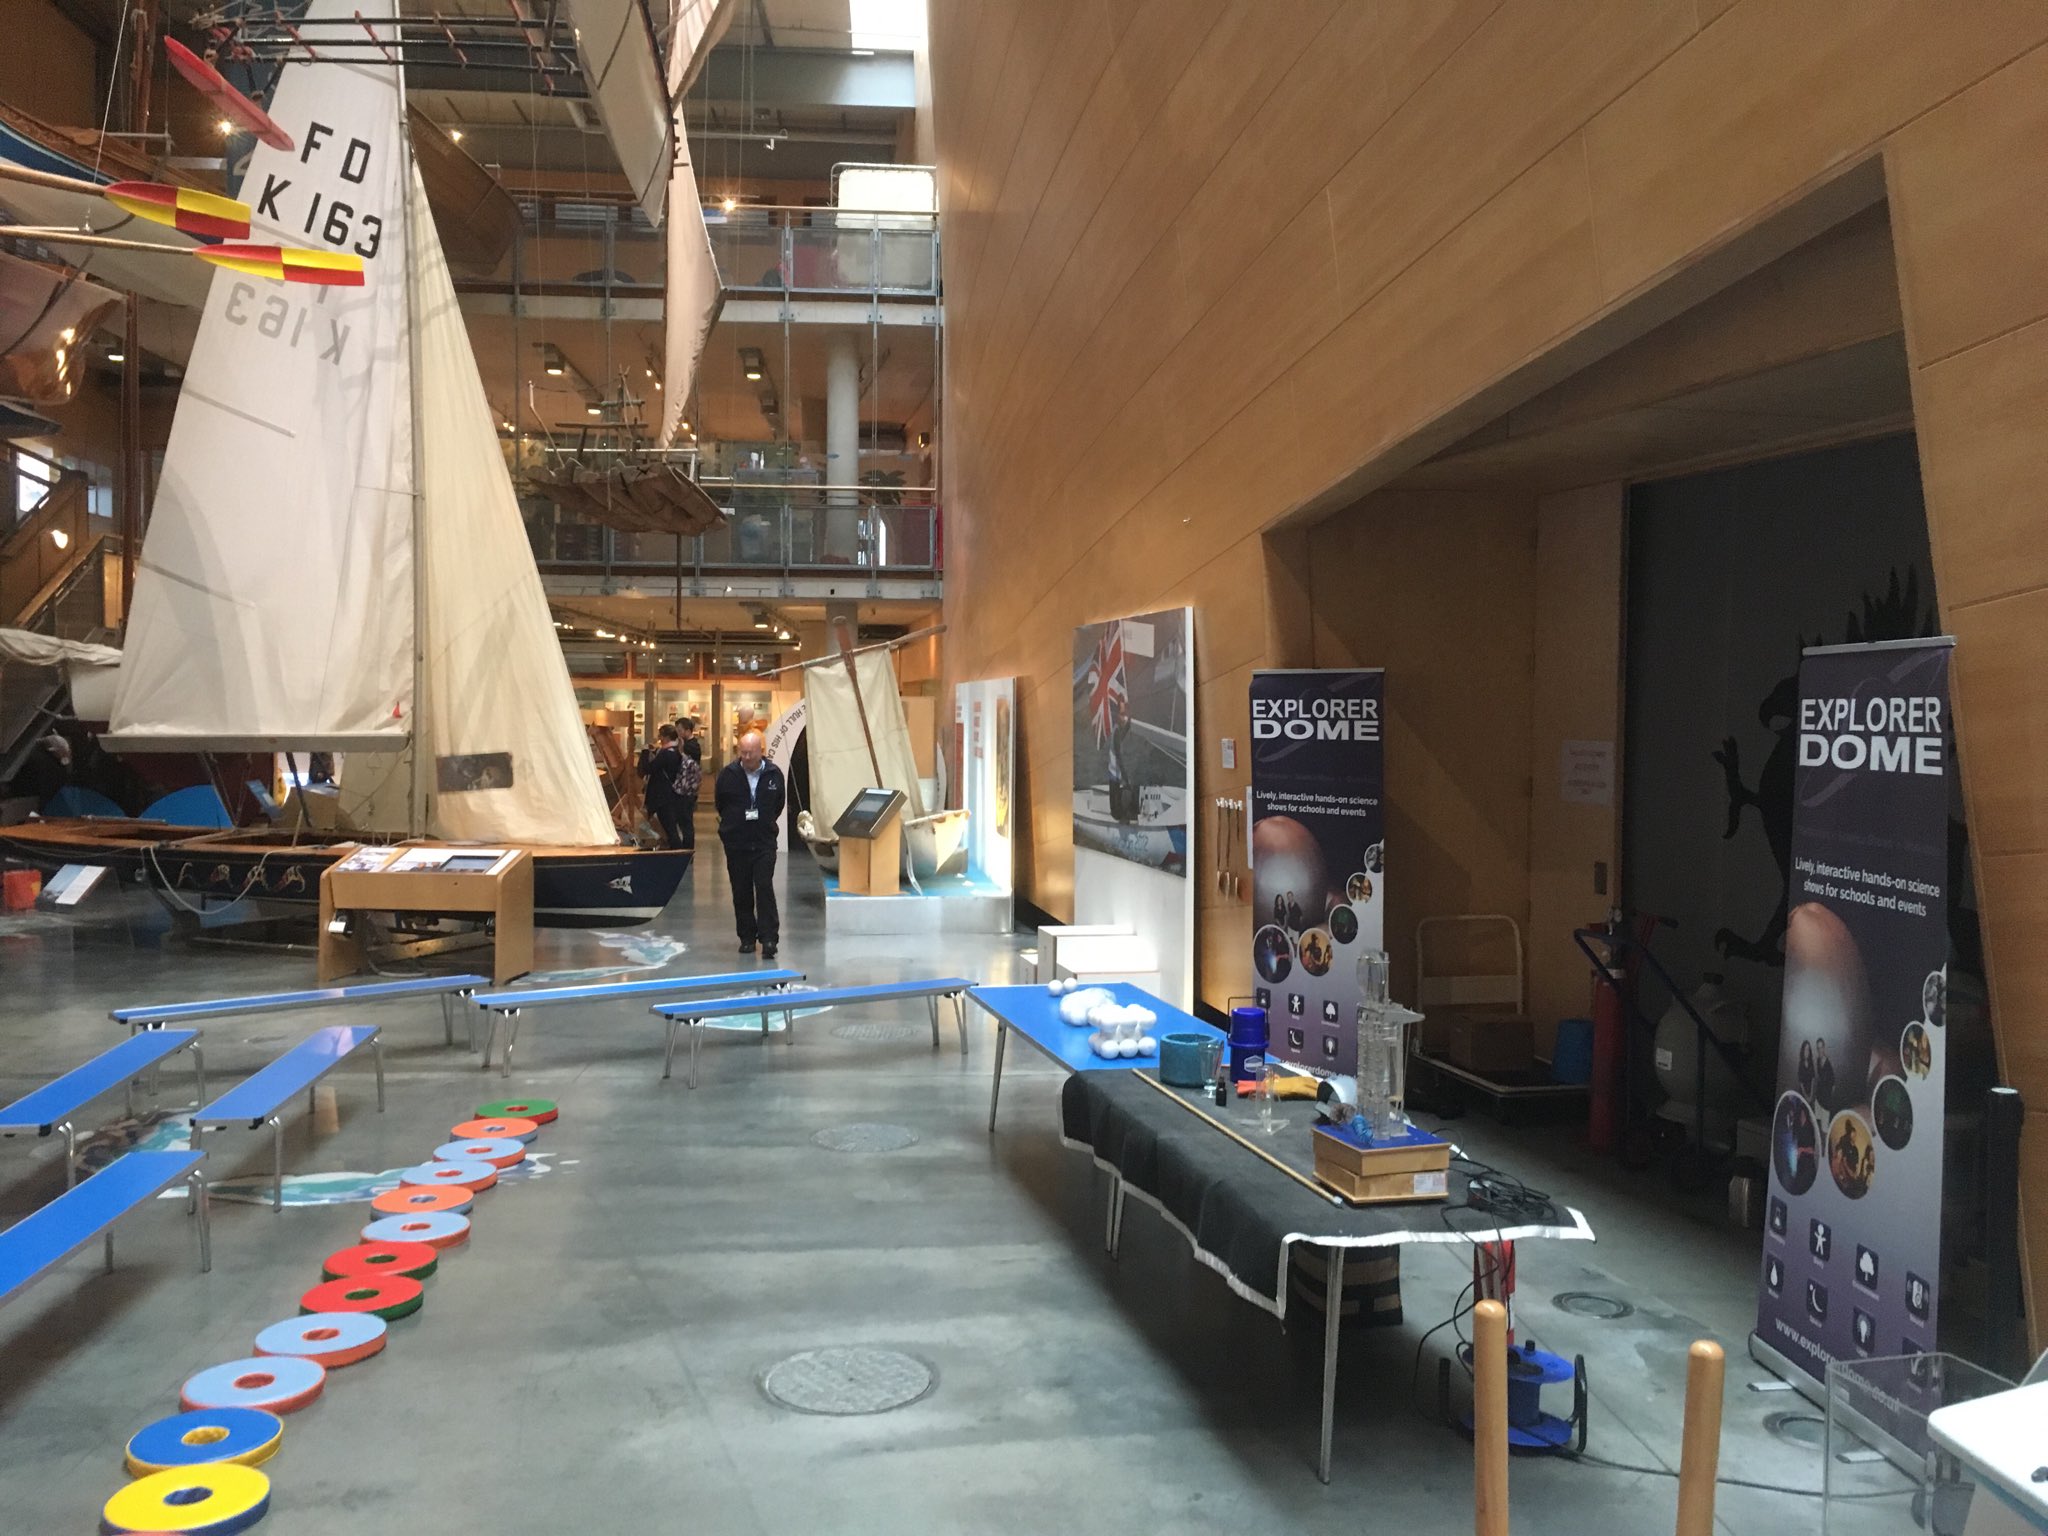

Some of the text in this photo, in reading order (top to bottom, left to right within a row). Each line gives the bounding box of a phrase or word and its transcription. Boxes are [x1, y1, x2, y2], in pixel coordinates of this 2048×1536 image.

[304, 192, 383, 259] 163
[786, 708, 803, 726] HULL
[1252, 698, 1378, 719] EXPLORER
[1801, 697, 1942, 733] EXPLORER
[779, 724, 789, 737] OF
[1253, 720, 1380, 741] DOME
[771, 734, 782, 749] HIS
[1799, 734, 1943, 775] DOME
[1256, 790, 1379, 806] Lively, interactive hands-on science
[1266, 802, 1367, 818] shows for schools and events
[1795, 857, 1941, 898] Lively, interactive hands-on science
[1803, 878, 1927, 917] shows for schools and events
